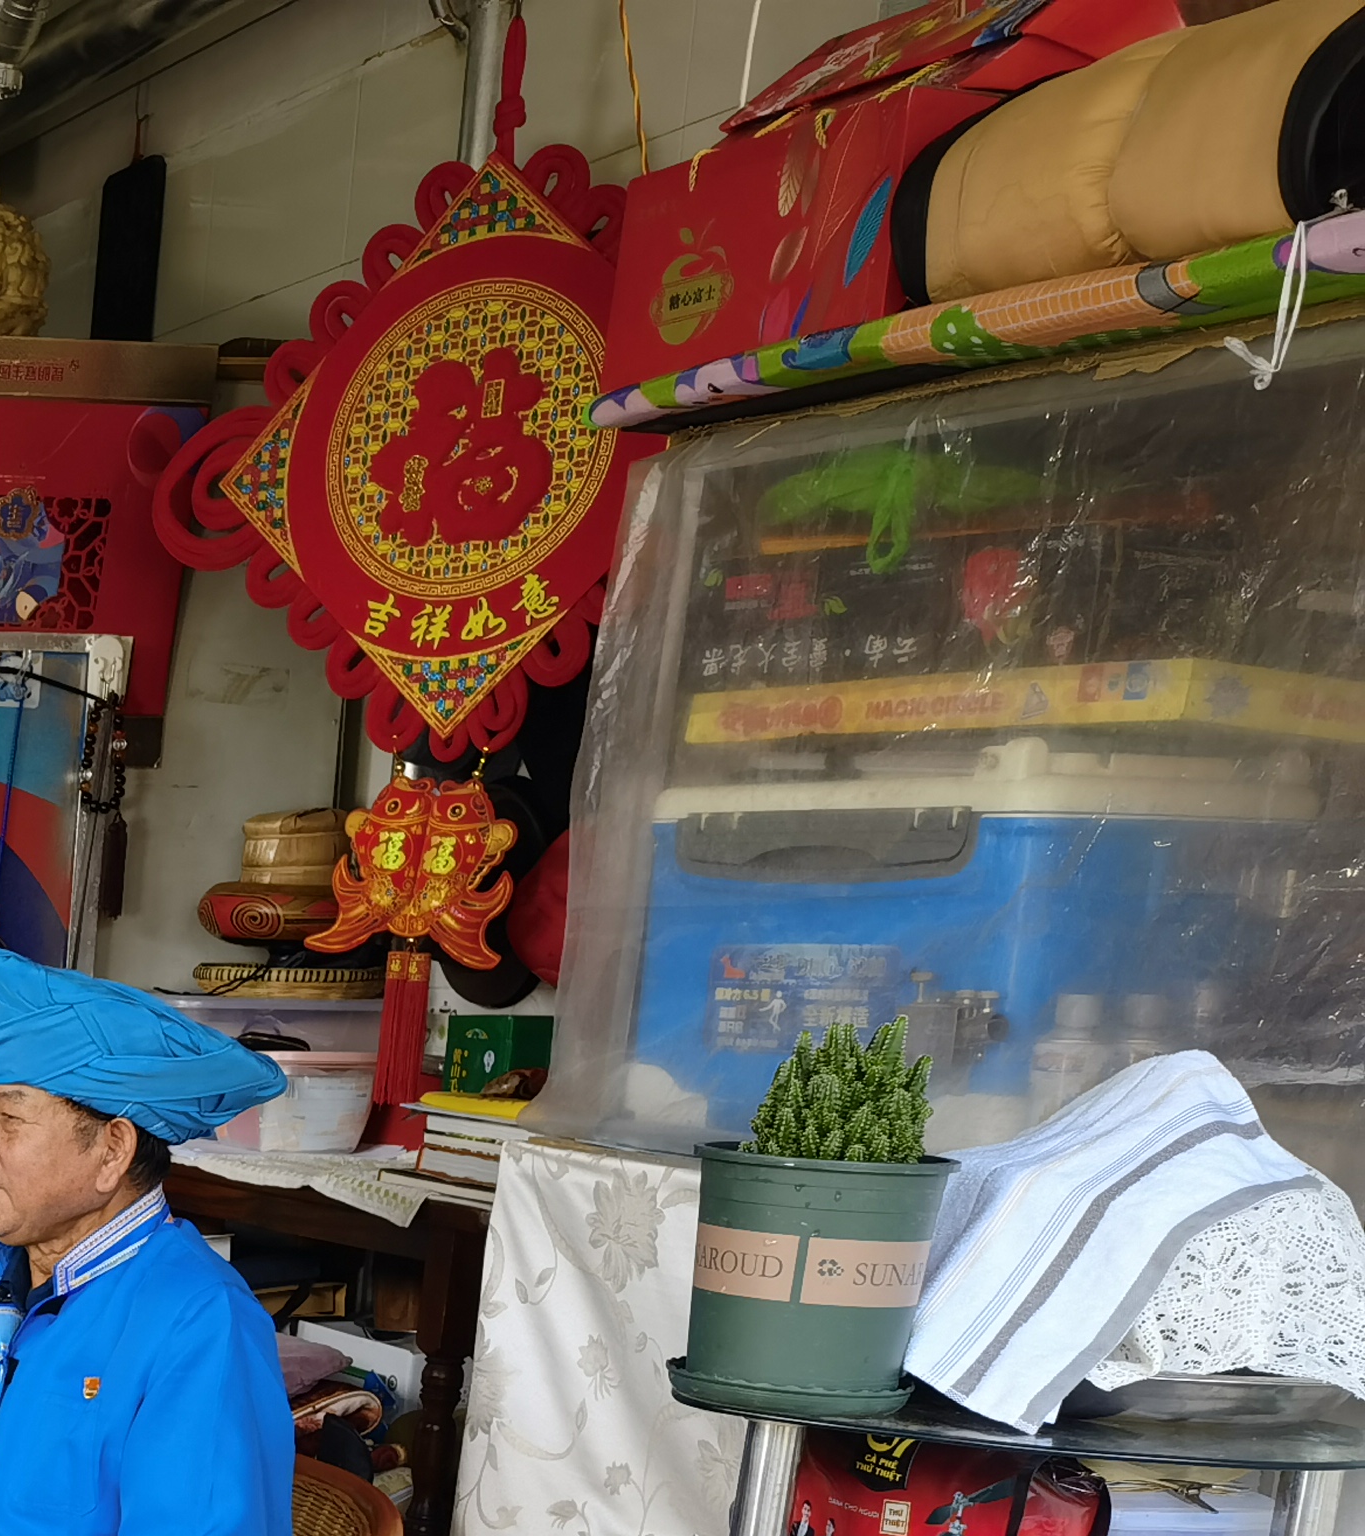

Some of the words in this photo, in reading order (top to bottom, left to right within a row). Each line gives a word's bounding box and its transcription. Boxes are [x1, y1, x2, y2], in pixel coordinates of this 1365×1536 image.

[363, 572, 561, 651] 吉祥如意
[371, 831, 407, 871] 福
[422, 835, 457, 876] 福
